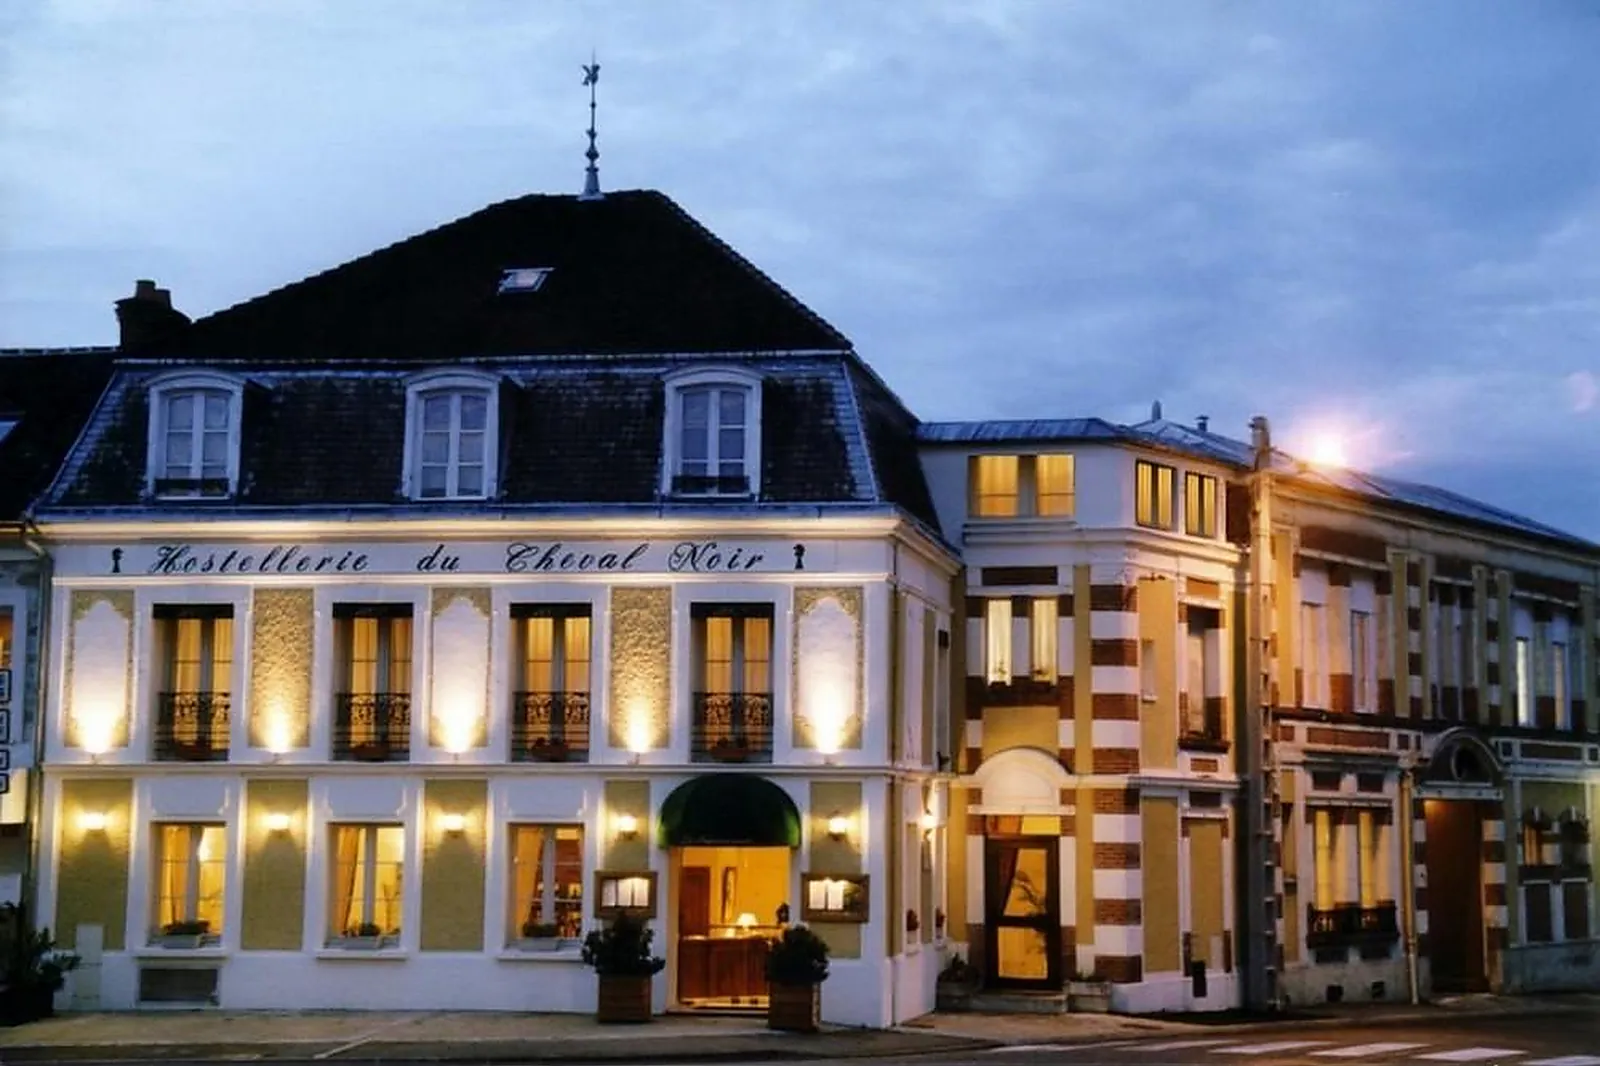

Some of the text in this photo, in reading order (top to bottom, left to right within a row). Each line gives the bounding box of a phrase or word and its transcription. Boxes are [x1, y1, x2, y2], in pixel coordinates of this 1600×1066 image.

[148, 541, 764, 574] Hostellerie du Cheval Noir
